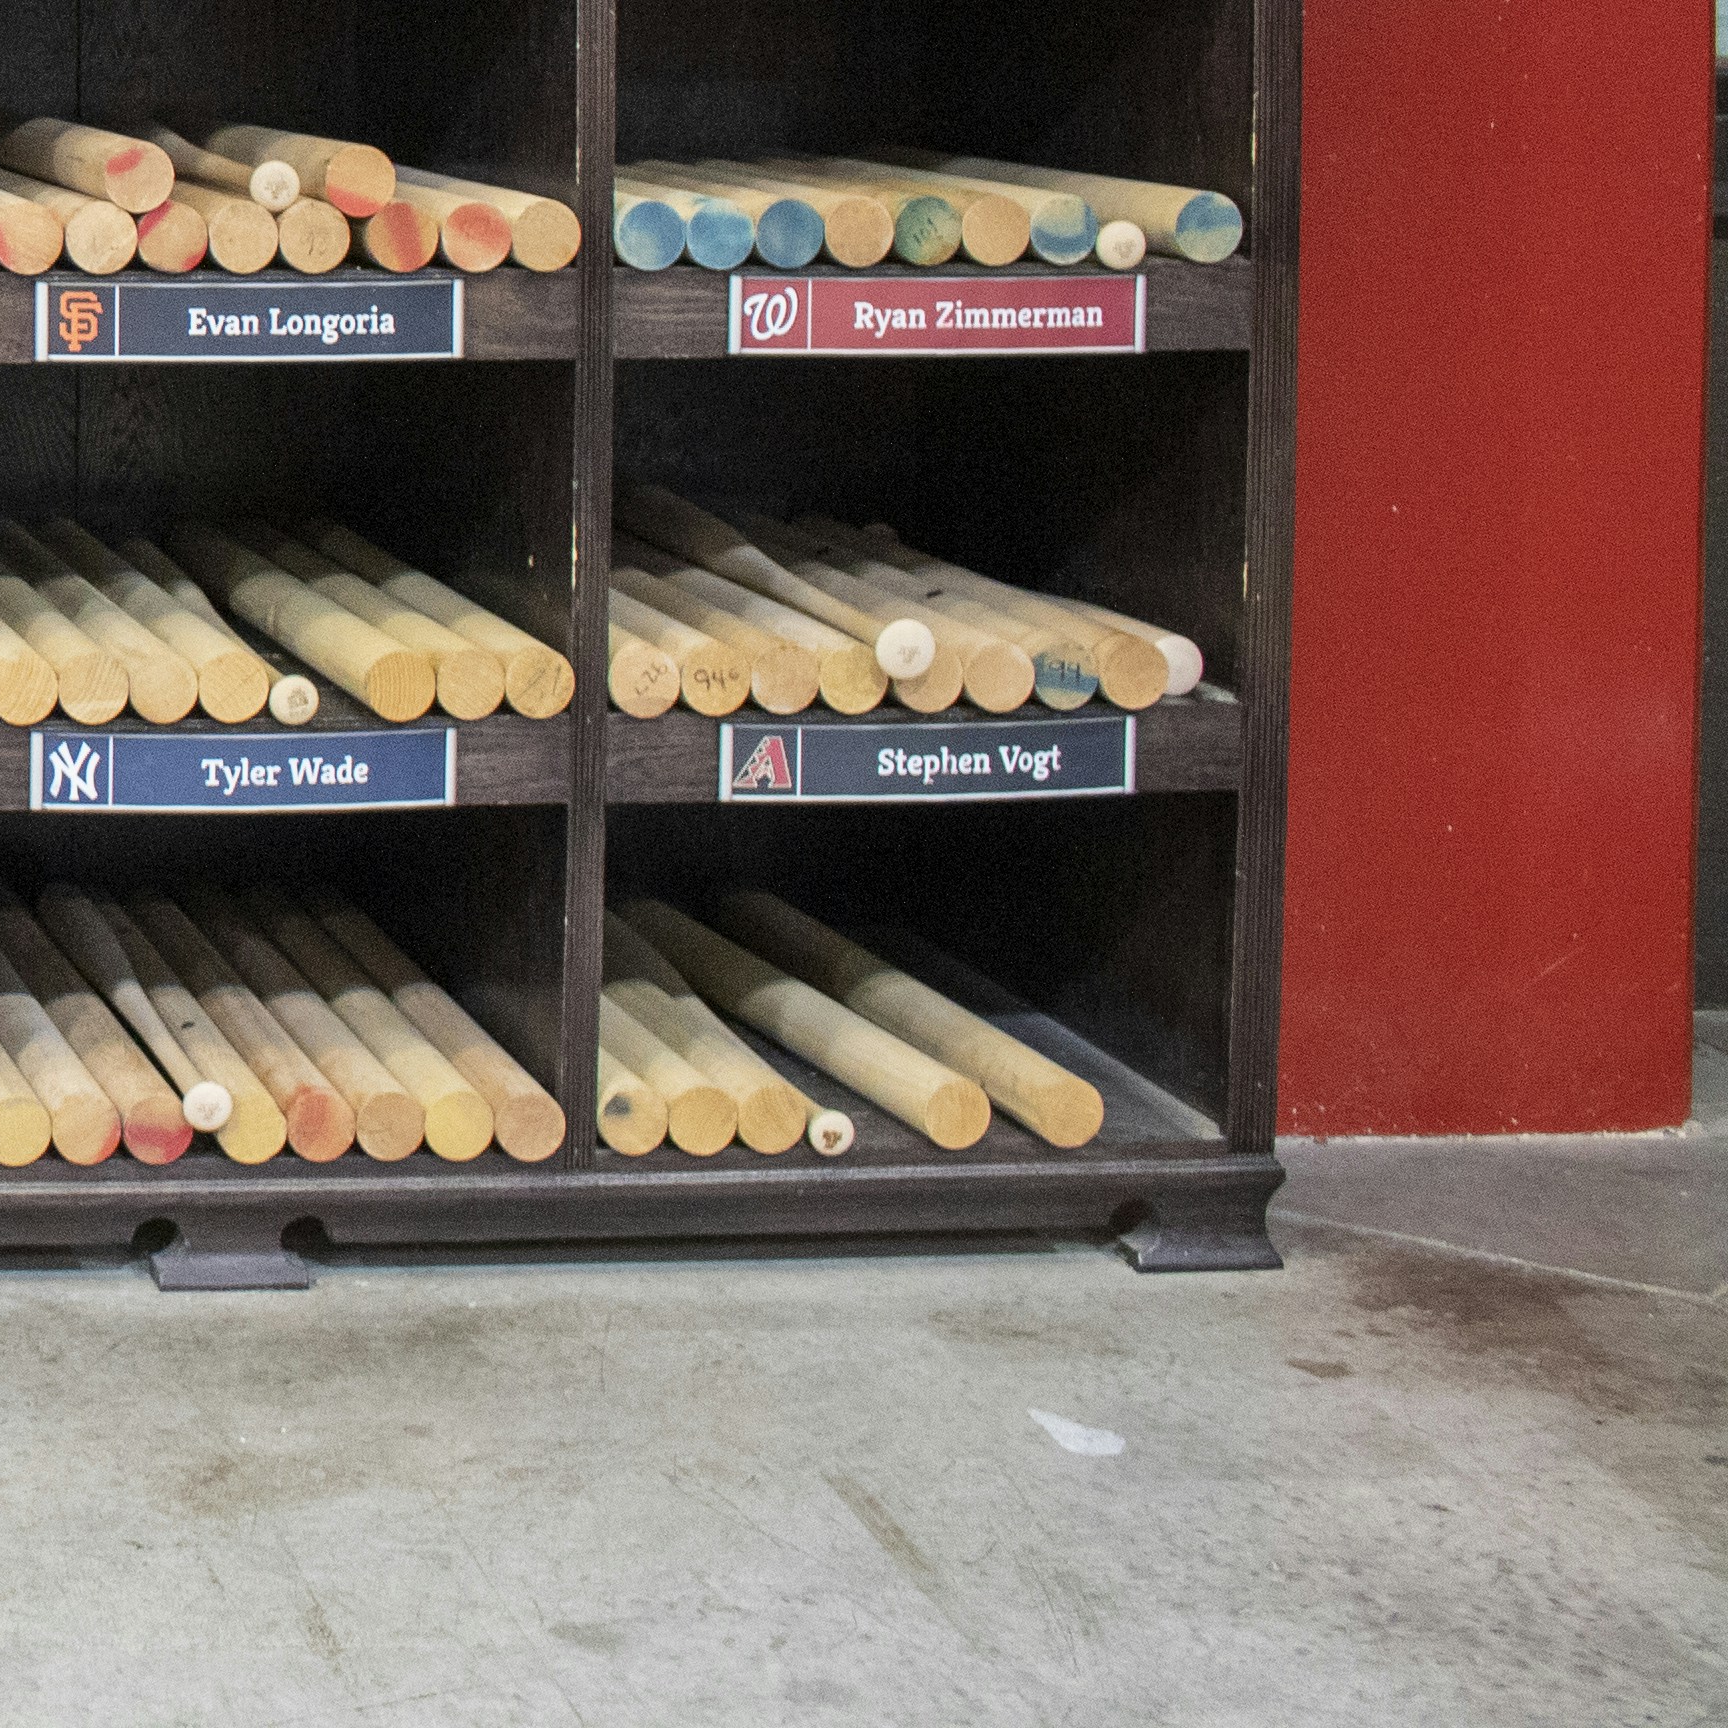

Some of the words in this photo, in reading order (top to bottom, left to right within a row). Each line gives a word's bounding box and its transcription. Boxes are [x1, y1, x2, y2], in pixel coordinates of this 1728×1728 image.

[189, 308, 259, 335] Evan
[270, 305, 395, 344] Longoria
[854, 302, 926, 338] Ryan
[936, 300, 1102, 328] Zimmerman
[202, 758, 280, 788] Tyler
[289, 756, 368, 785] Wade
[878, 747, 991, 784] Stephen
[999, 745, 1061, 780] Vogt
